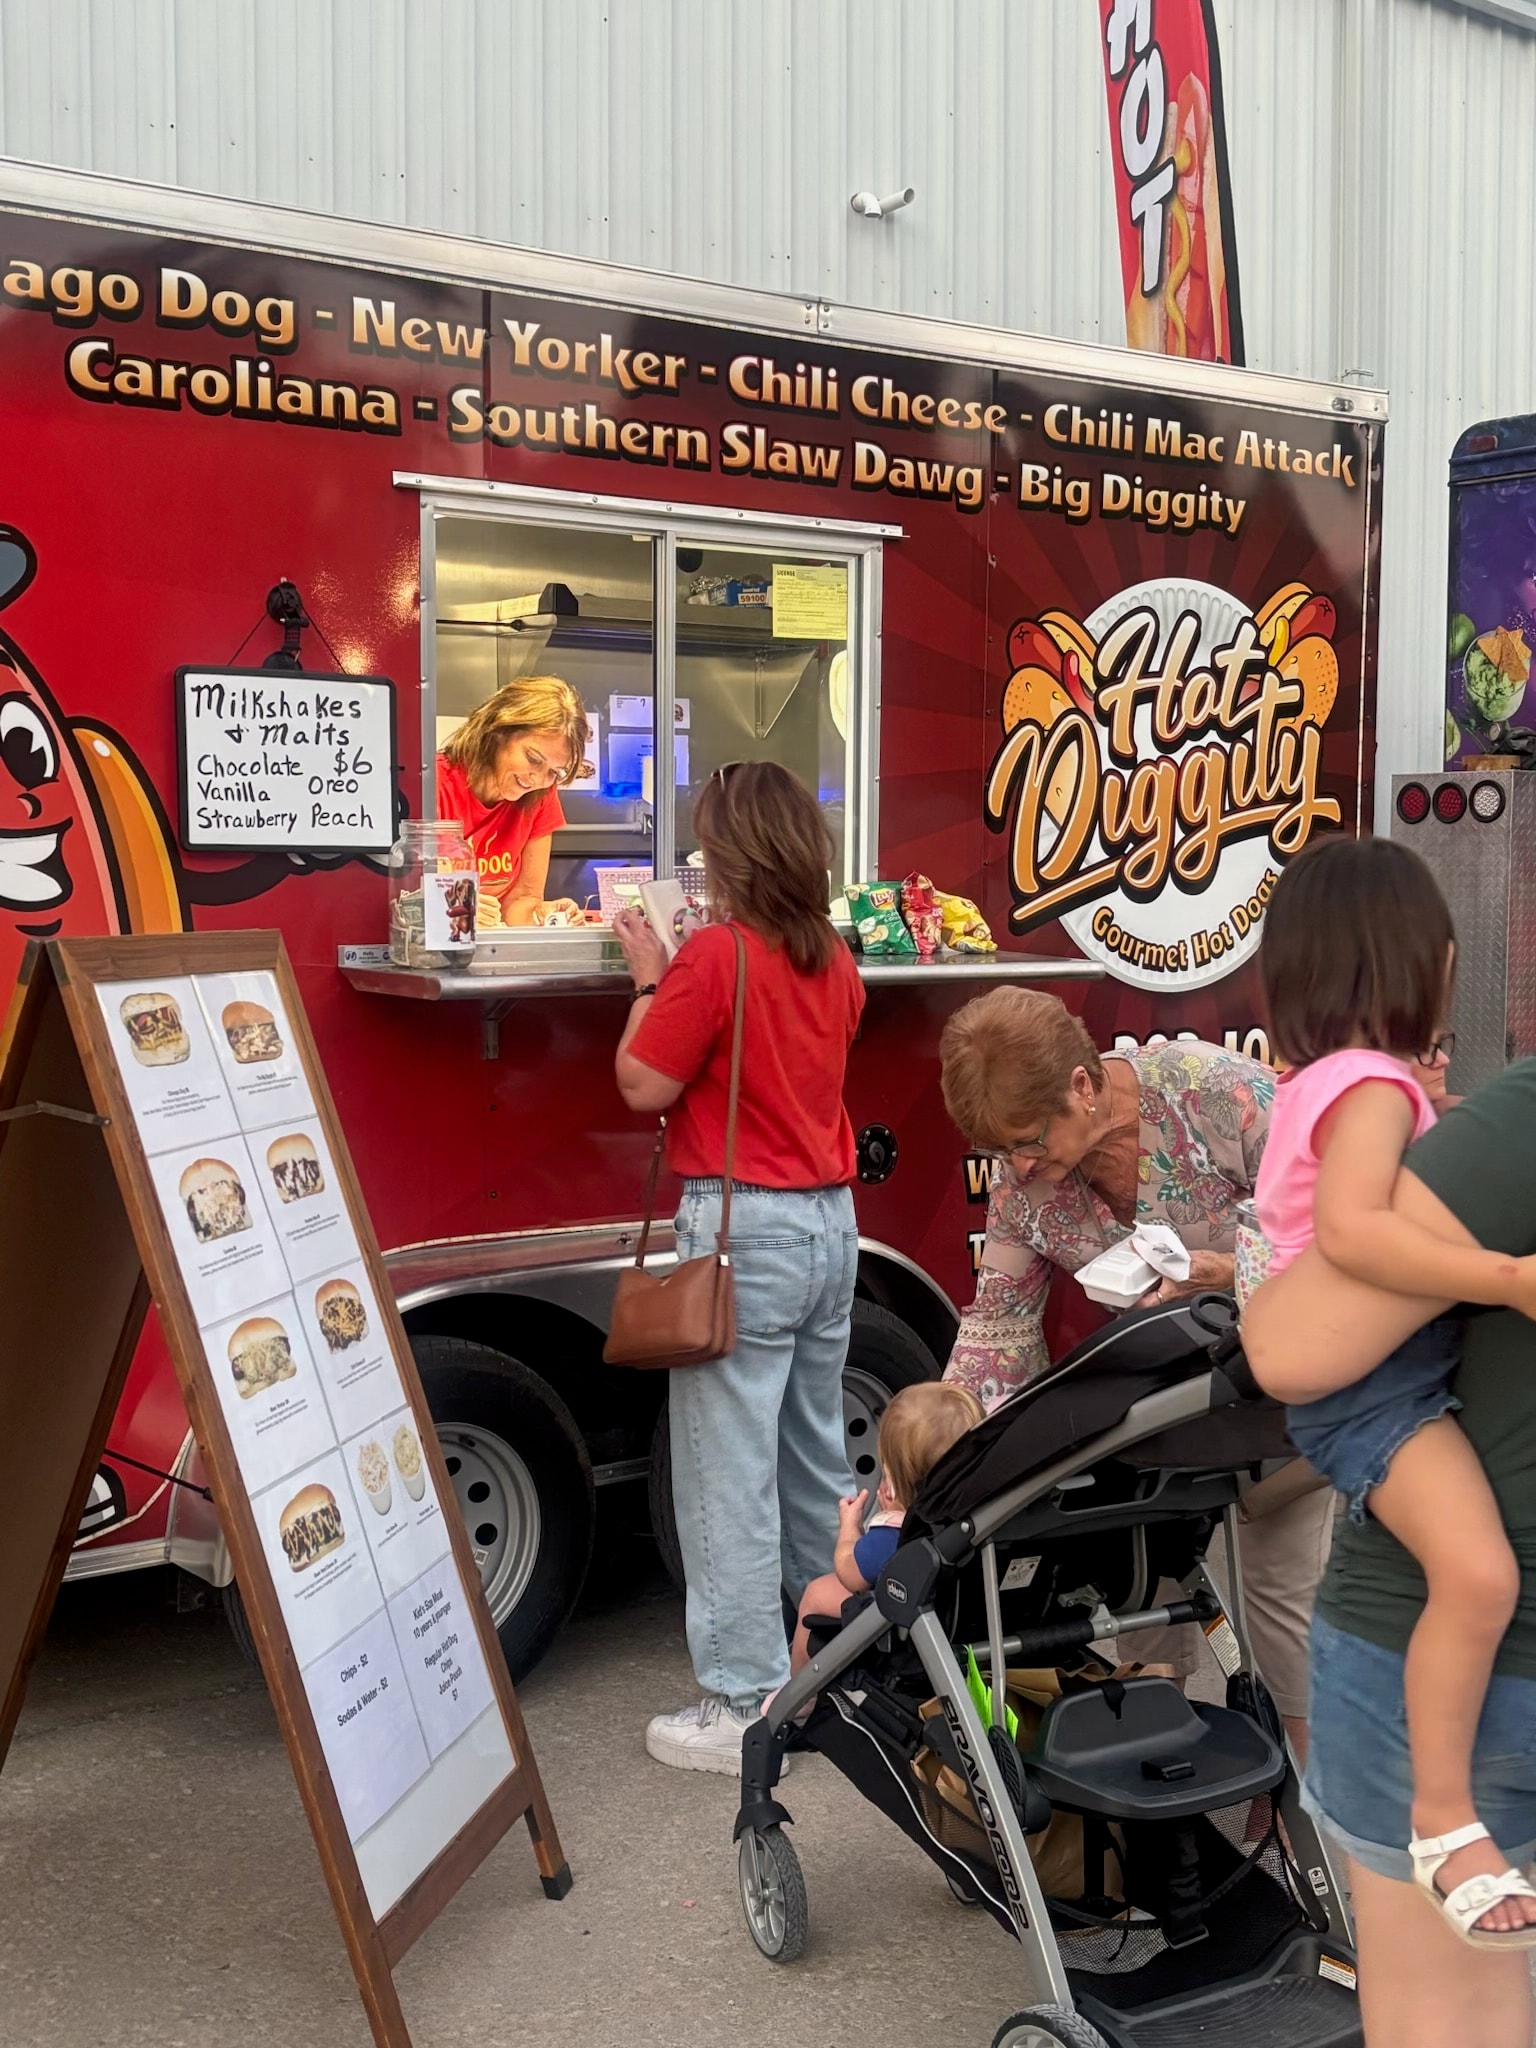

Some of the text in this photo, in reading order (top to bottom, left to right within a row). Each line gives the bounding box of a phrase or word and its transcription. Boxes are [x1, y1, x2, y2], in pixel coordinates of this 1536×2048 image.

[160, 268, 297, 346] Dog
[352, 296, 488, 360] New
[503, 319, 687, 391] Yorker
[728, 356, 838, 413] Chili
[851, 374, 1007, 433] Cheese
[1043, 402, 1135, 451] Chili
[1143, 417, 1224, 462] Mac
[1234, 430, 1354, 488] Attack
[68, 340, 398, 428] Caroliana
[450, 388, 708, 464] Southern
[720, 424, 841, 482] Slaw
[853, 442, 985, 509] Dawg
[1020, 465, 1092, 517] Big
[1102, 473, 1247, 535] Diggity
[191, 683, 361, 719] Milkshakes
[1098, 610, 1268, 757] Hot
[259, 722, 350, 746] Malts
[197, 746, 373, 777] Chocolate $6
[197, 776, 359, 802] Vanilla Oreo
[988, 672, 1341, 895] Diggity
[196, 802, 374, 834] Strawberry Peach
[478, 852, 513, 877] DOG
[1093, 906, 1188, 972] Gourmet
[1191, 922, 1233, 968] Hot
[413, 1627, 420, 1639] 10
[420, 1619, 433, 1637] years
[340, 1664, 358, 1683] Chips
[360, 1653, 368, 1667] $2
[424, 1648, 442, 1669] Regular
[448, 1633, 458, 1646] Dog
[337, 1706, 358, 1727] Sodas
[357, 1699, 363, 1711] &
[361, 1687, 378, 1707] Water
[380, 1676, 389, 1690] $2
